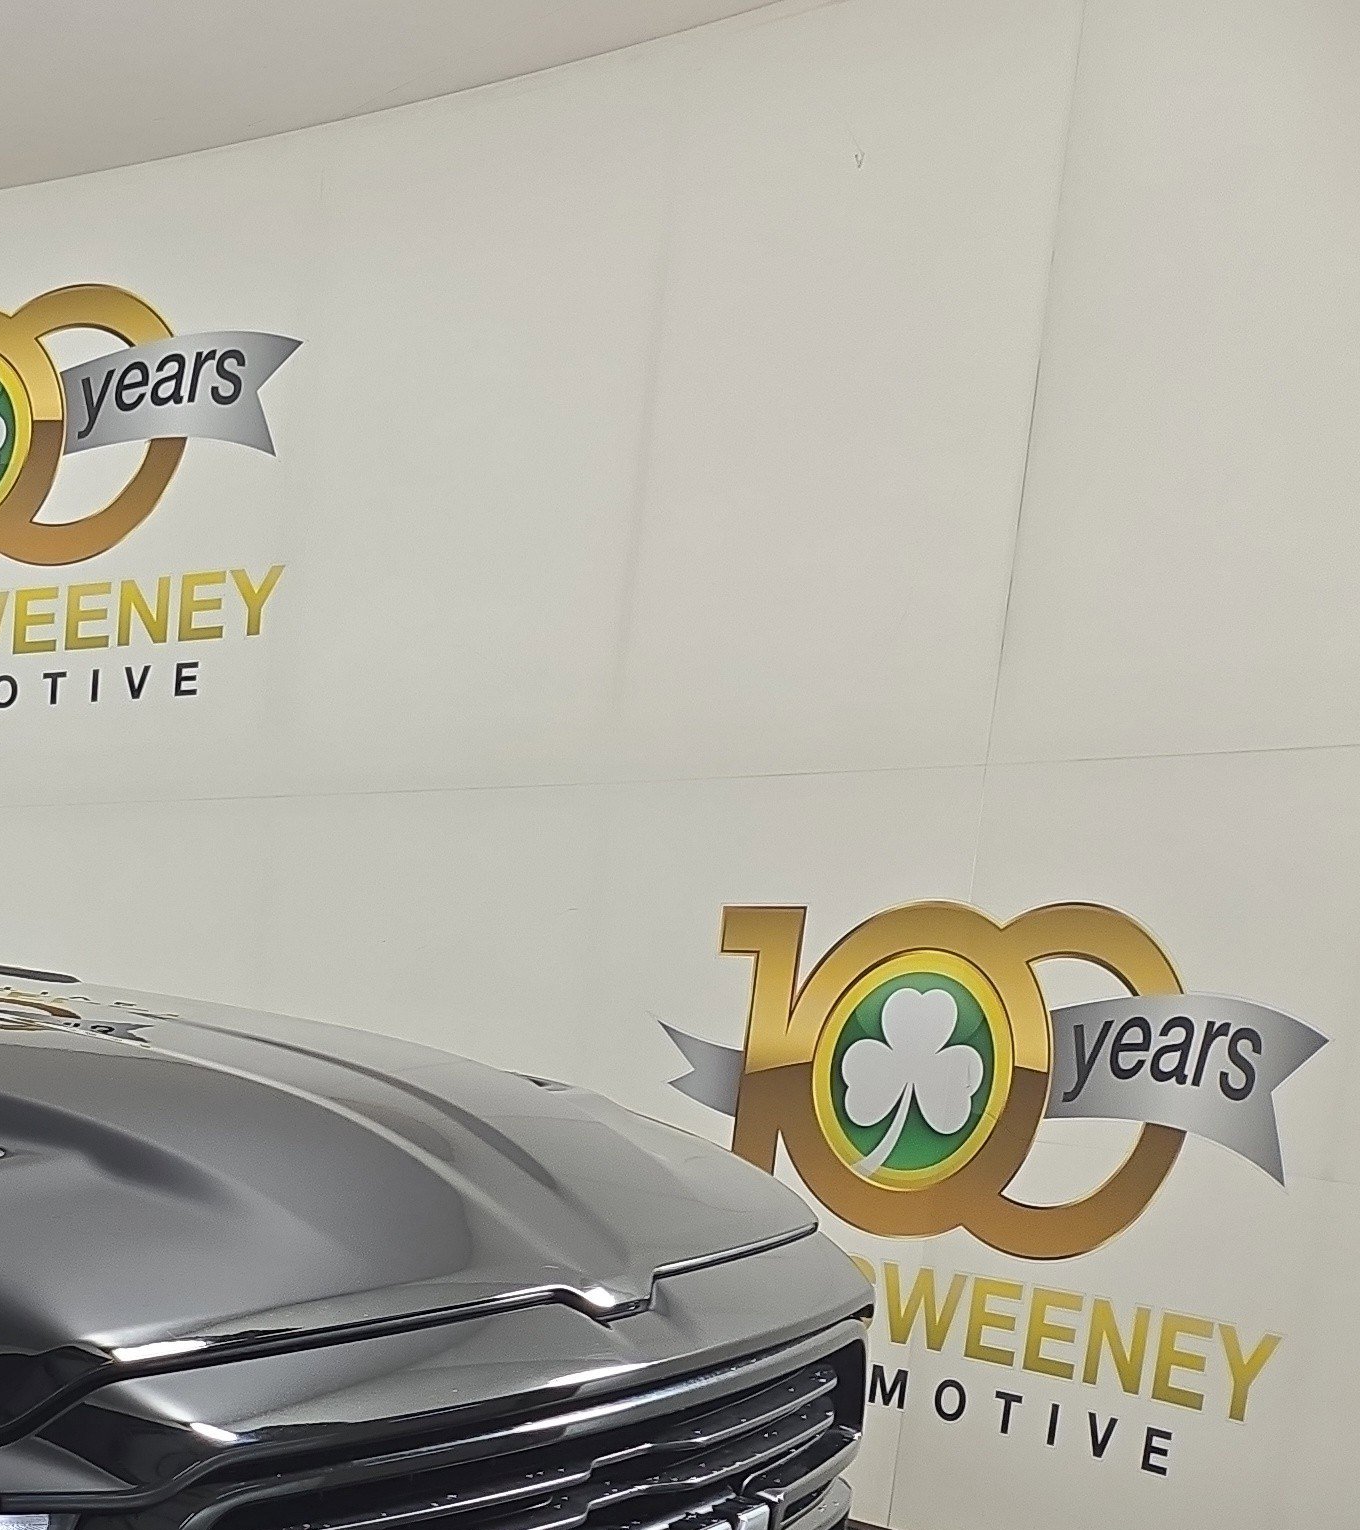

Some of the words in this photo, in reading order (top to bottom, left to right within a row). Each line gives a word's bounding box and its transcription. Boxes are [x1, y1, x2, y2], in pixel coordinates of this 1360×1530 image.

[77, 345, 246, 440] years
[1062, 1014, 1262, 1104] years
[868, 1364, 1174, 1477] MOTIVE
